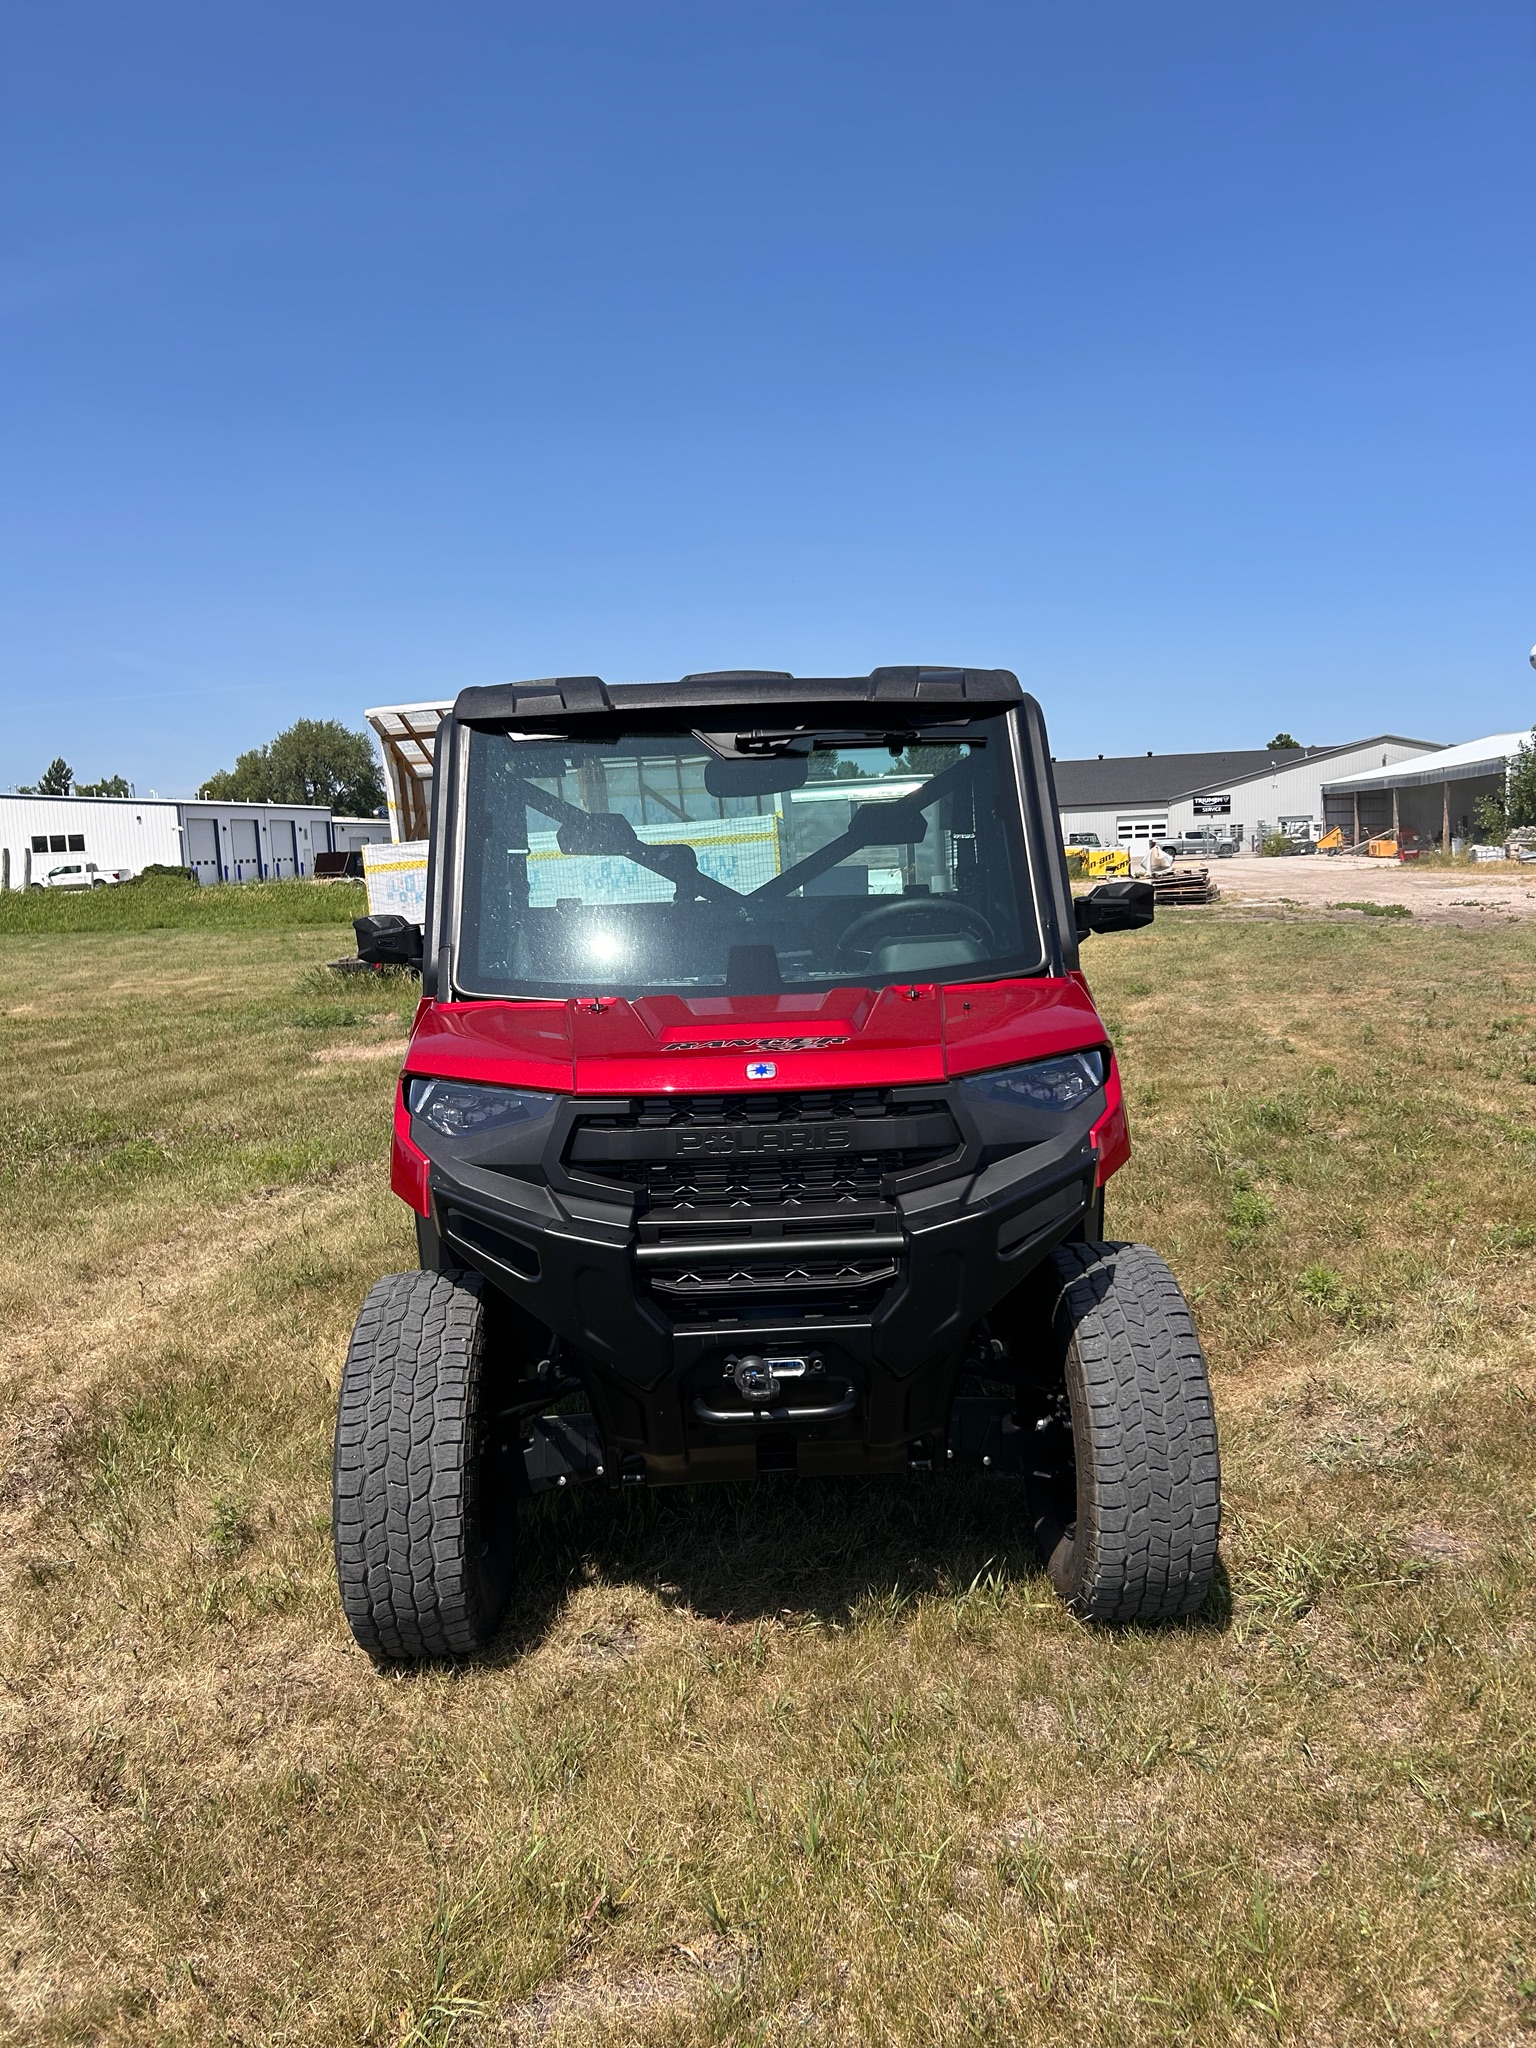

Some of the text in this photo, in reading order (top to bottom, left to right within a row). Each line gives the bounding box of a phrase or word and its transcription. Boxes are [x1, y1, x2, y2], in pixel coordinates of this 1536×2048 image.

[1090, 852, 1115, 869] n-am
[661, 1036, 850, 1051] RANGER
[676, 1127, 851, 1155] POLARIS
